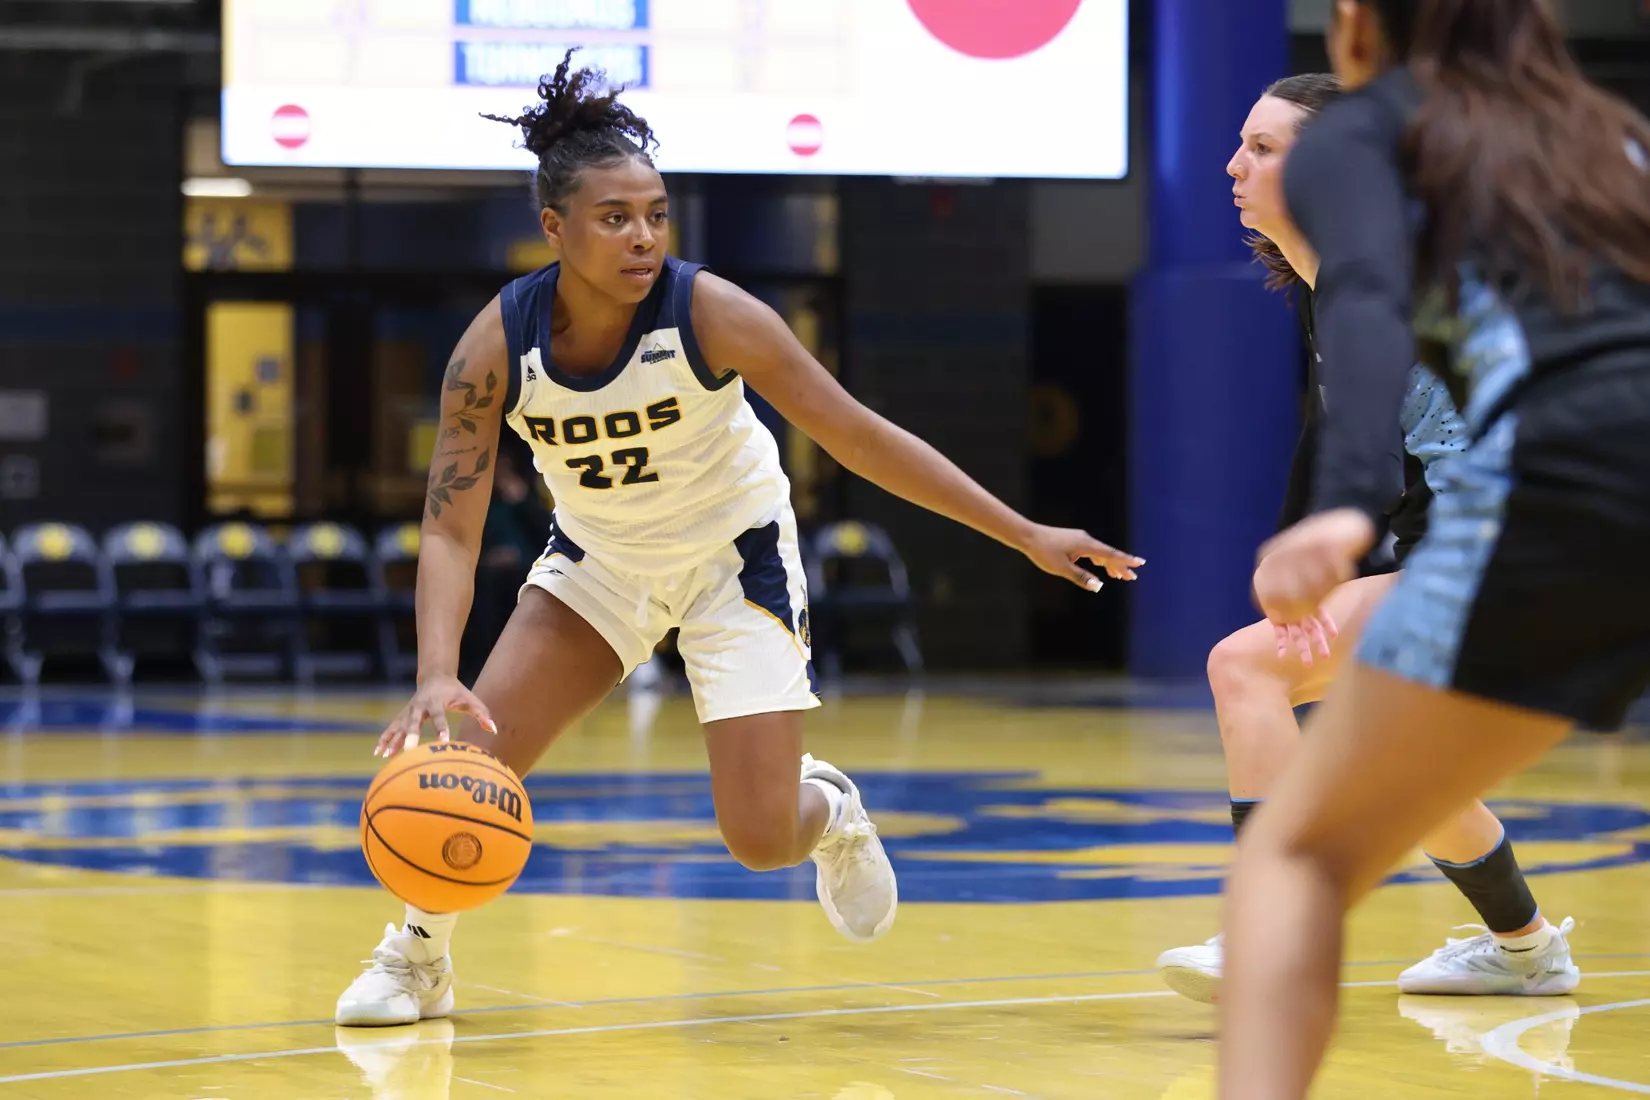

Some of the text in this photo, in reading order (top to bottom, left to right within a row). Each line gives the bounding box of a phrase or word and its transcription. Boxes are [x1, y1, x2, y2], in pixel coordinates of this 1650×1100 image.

[641, 350, 676, 363] SUMMIT
[522, 396, 681, 446] ROOS
[565, 447, 660, 489] 22
[419, 773, 522, 822] Wilson
